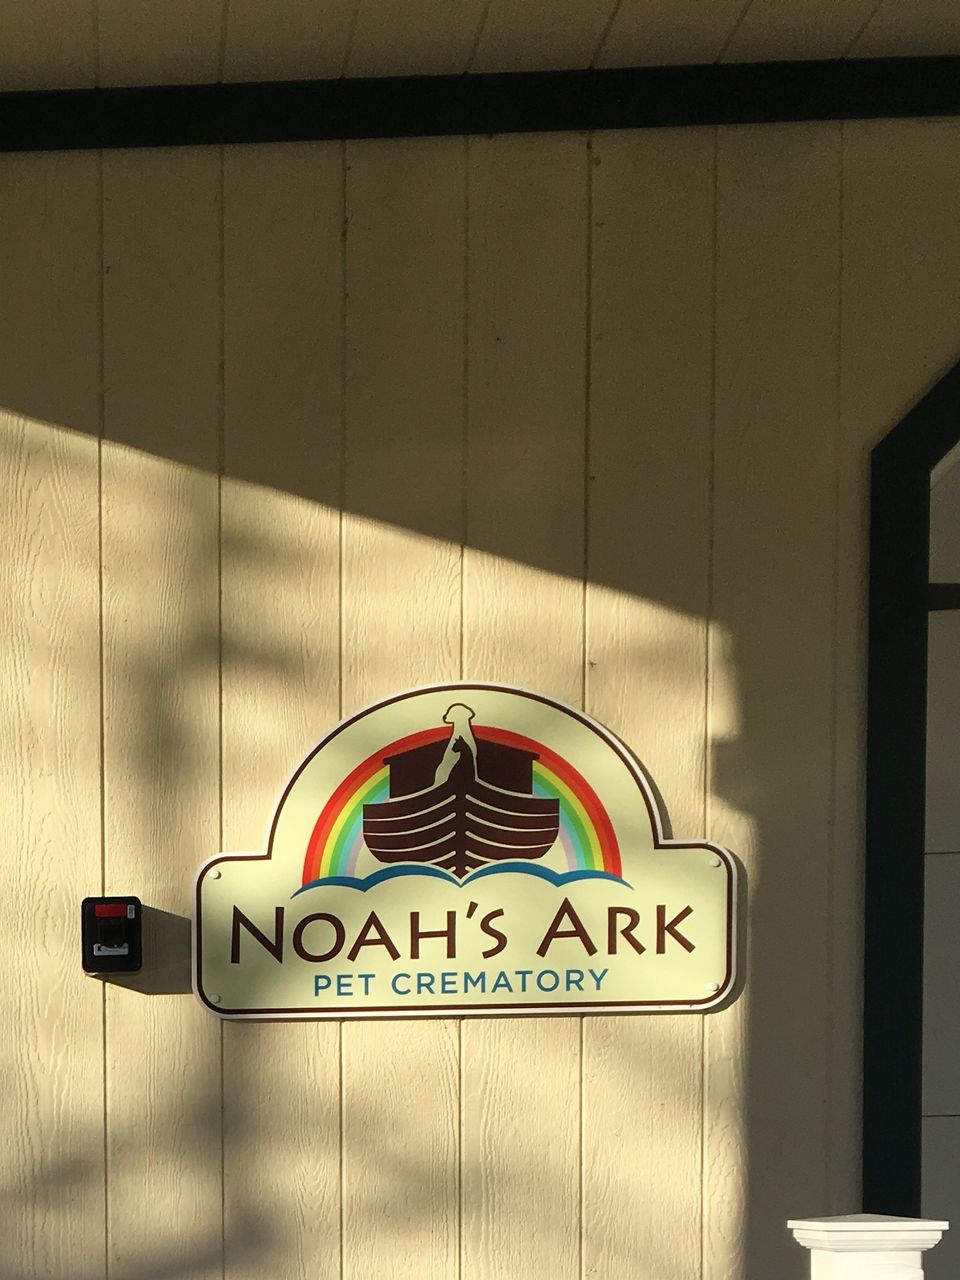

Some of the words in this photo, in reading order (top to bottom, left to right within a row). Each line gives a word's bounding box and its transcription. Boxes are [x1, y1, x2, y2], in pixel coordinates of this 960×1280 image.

[230, 901, 507, 964] NOAH'S
[537, 897, 696, 958] ARK
[313, 973, 375, 996] PET
[392, 968, 609, 995] CREMATORY
